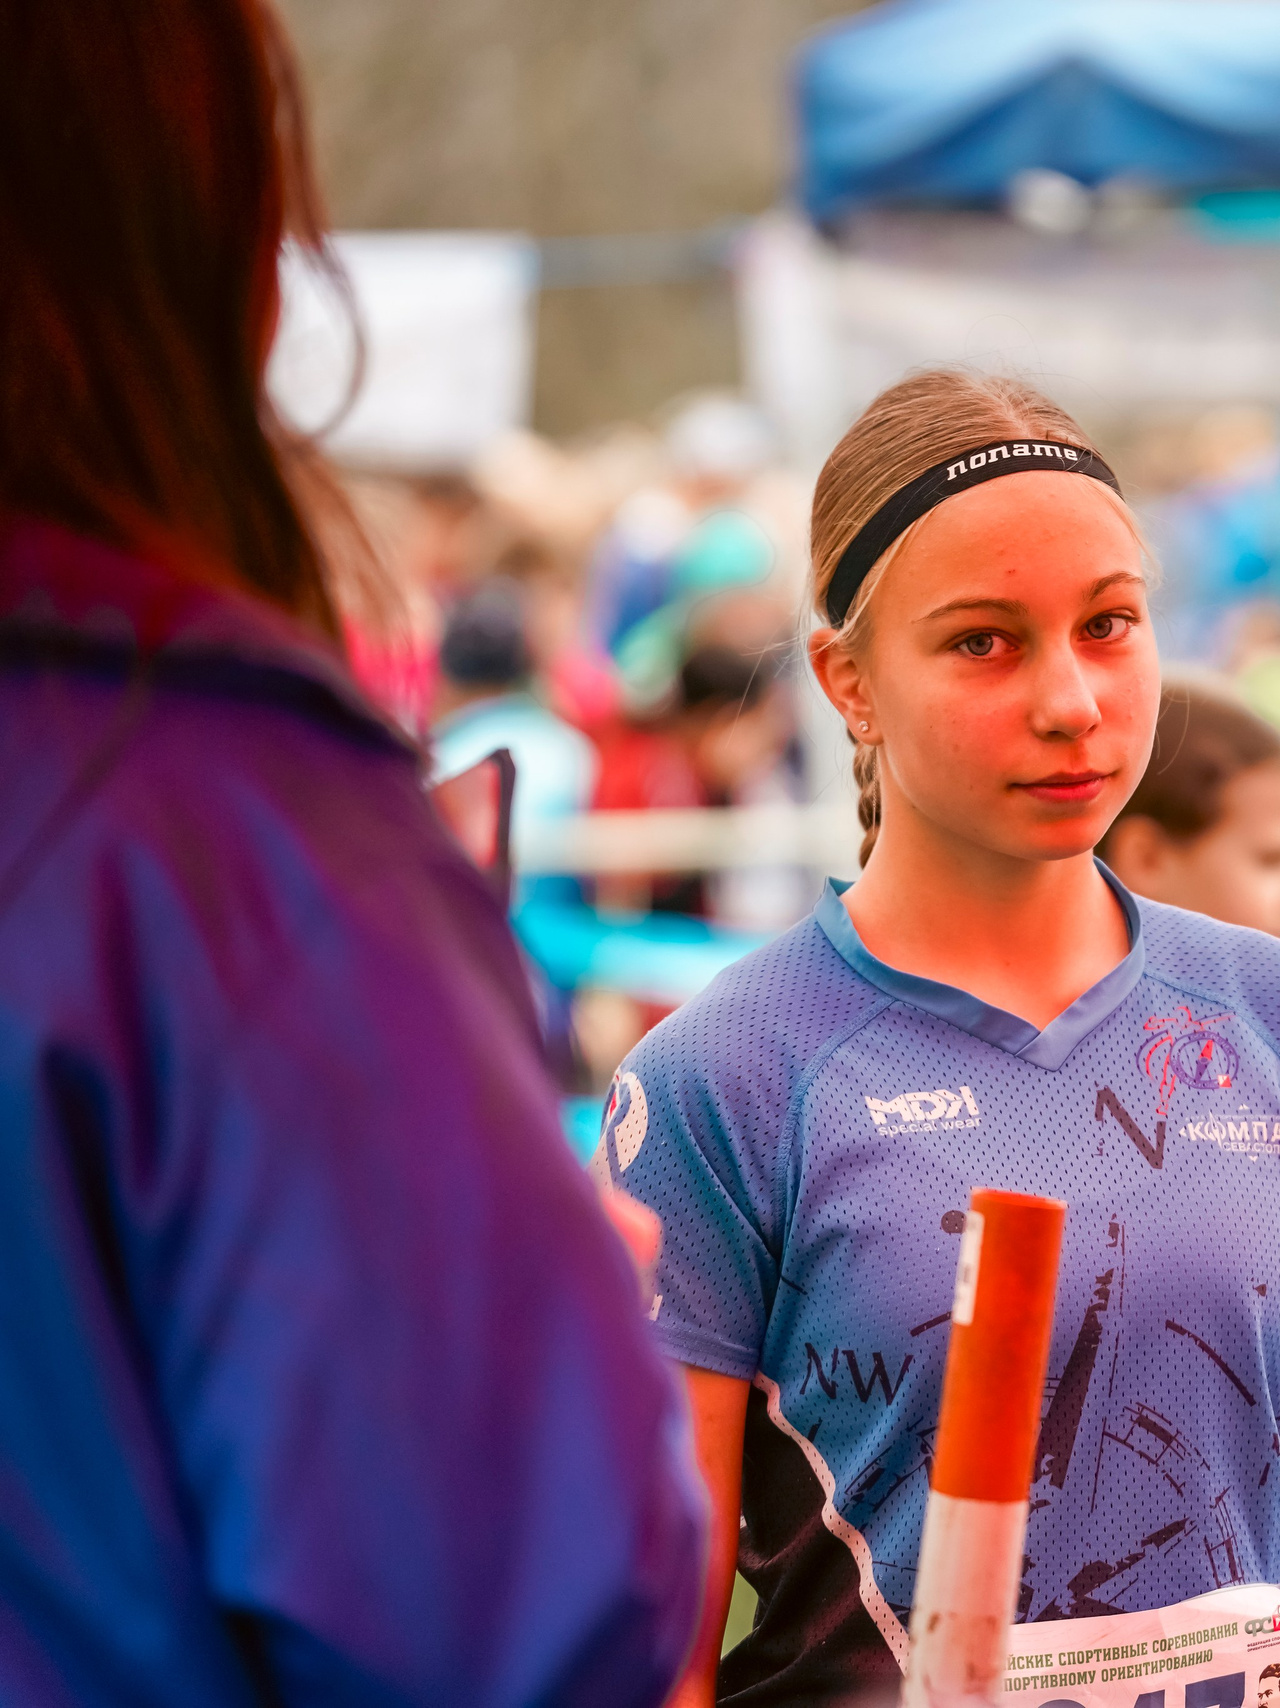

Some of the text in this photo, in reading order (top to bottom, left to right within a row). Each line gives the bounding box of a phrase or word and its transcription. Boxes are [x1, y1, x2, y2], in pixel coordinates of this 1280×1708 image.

[946, 443, 1079, 481] noname
[864, 1086, 980, 1125] MDK
[878, 1117, 982, 1138] special wear
[800, 1342, 914, 1406] NW
[1004, 1621, 1239, 1671] ЙСКИЕ СПОРТИВНЫЕ СОРЕВНОВАНИЯ
[1002, 1669, 1097, 1692] ПОРТИВНОМУ
[1101, 1648, 1213, 1683] ОРИЕНТИРОВАНИЮ
